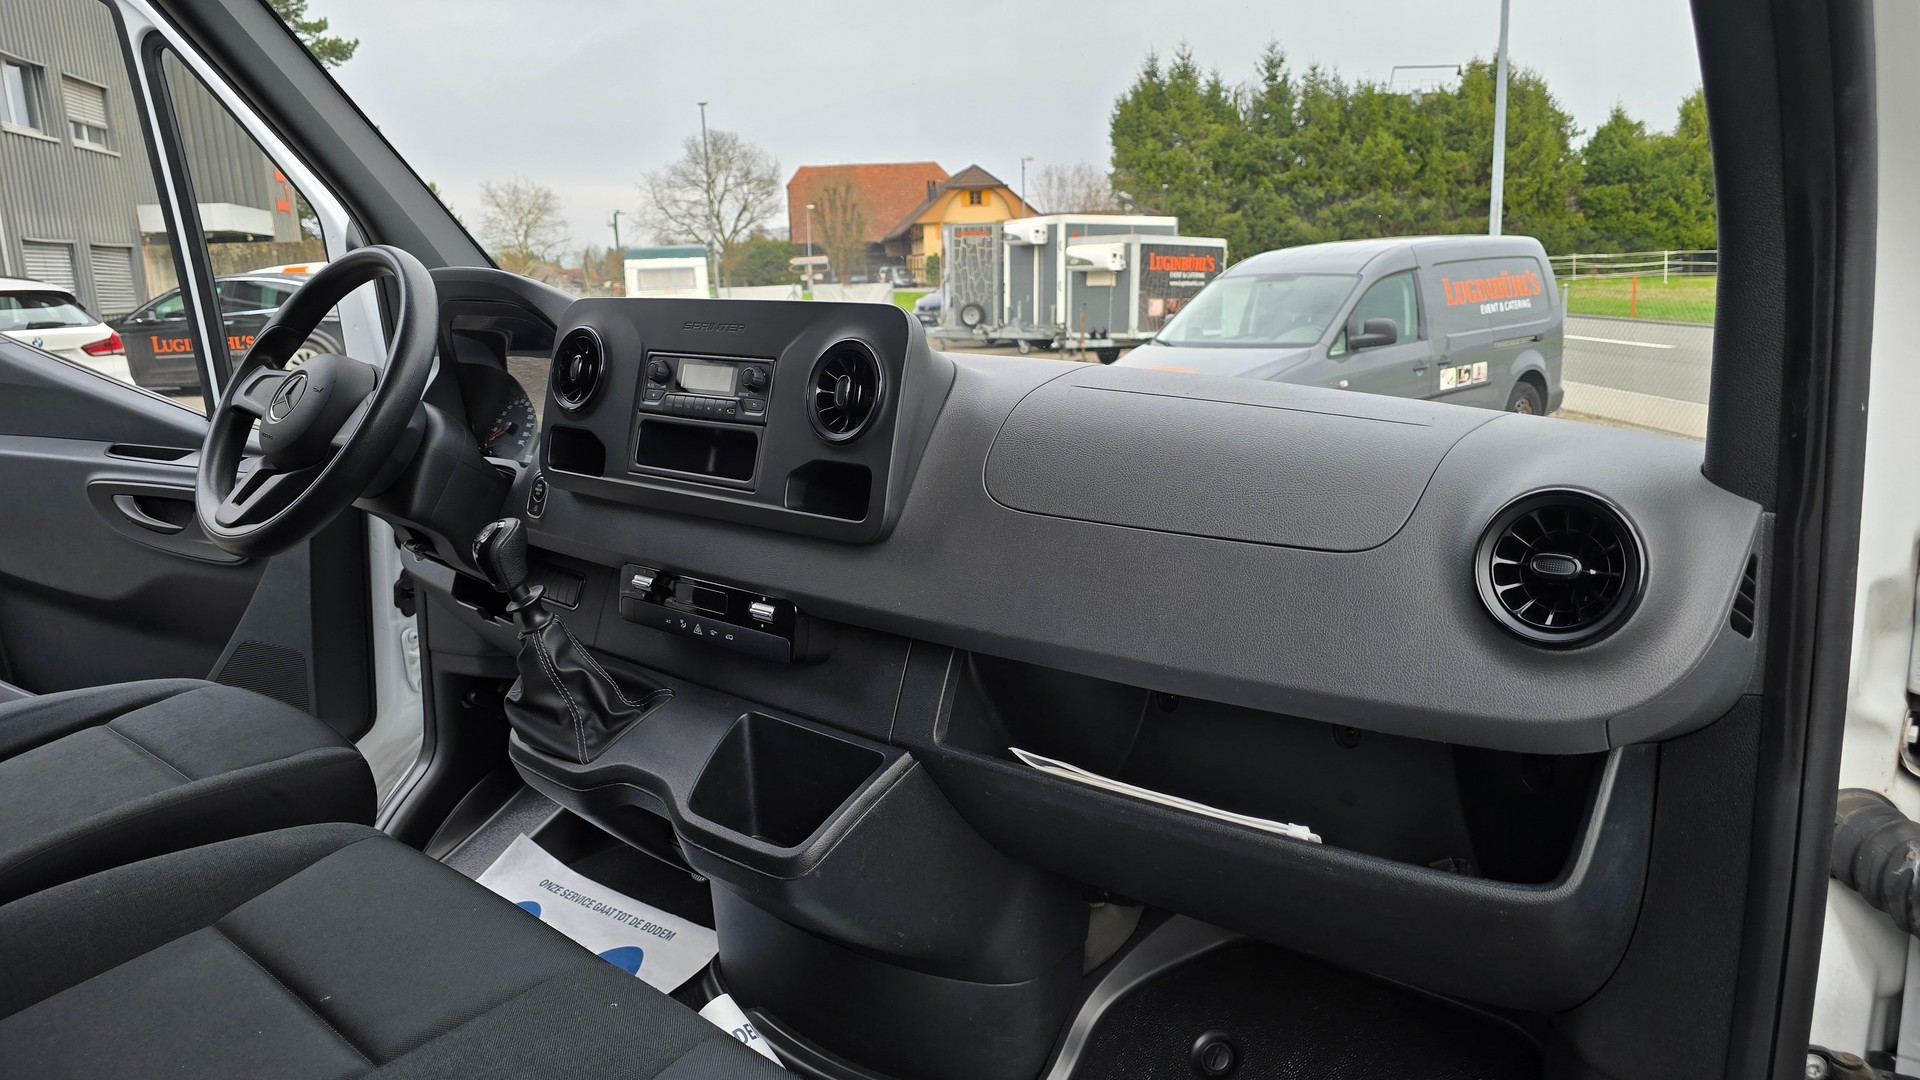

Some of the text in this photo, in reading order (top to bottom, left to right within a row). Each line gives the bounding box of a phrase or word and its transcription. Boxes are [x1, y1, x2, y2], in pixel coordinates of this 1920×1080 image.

[1149, 252, 1215, 272] LUGINBÜHL'S
[1442, 269, 1541, 306] LUGINBÜHL'S
[1480, 298, 1532, 315] EVENT & CATERING
[682, 321, 747, 333] SPRINTER
[539, 879, 677, 941] ONZE SERVICE GAAT TOT DE BODEM
